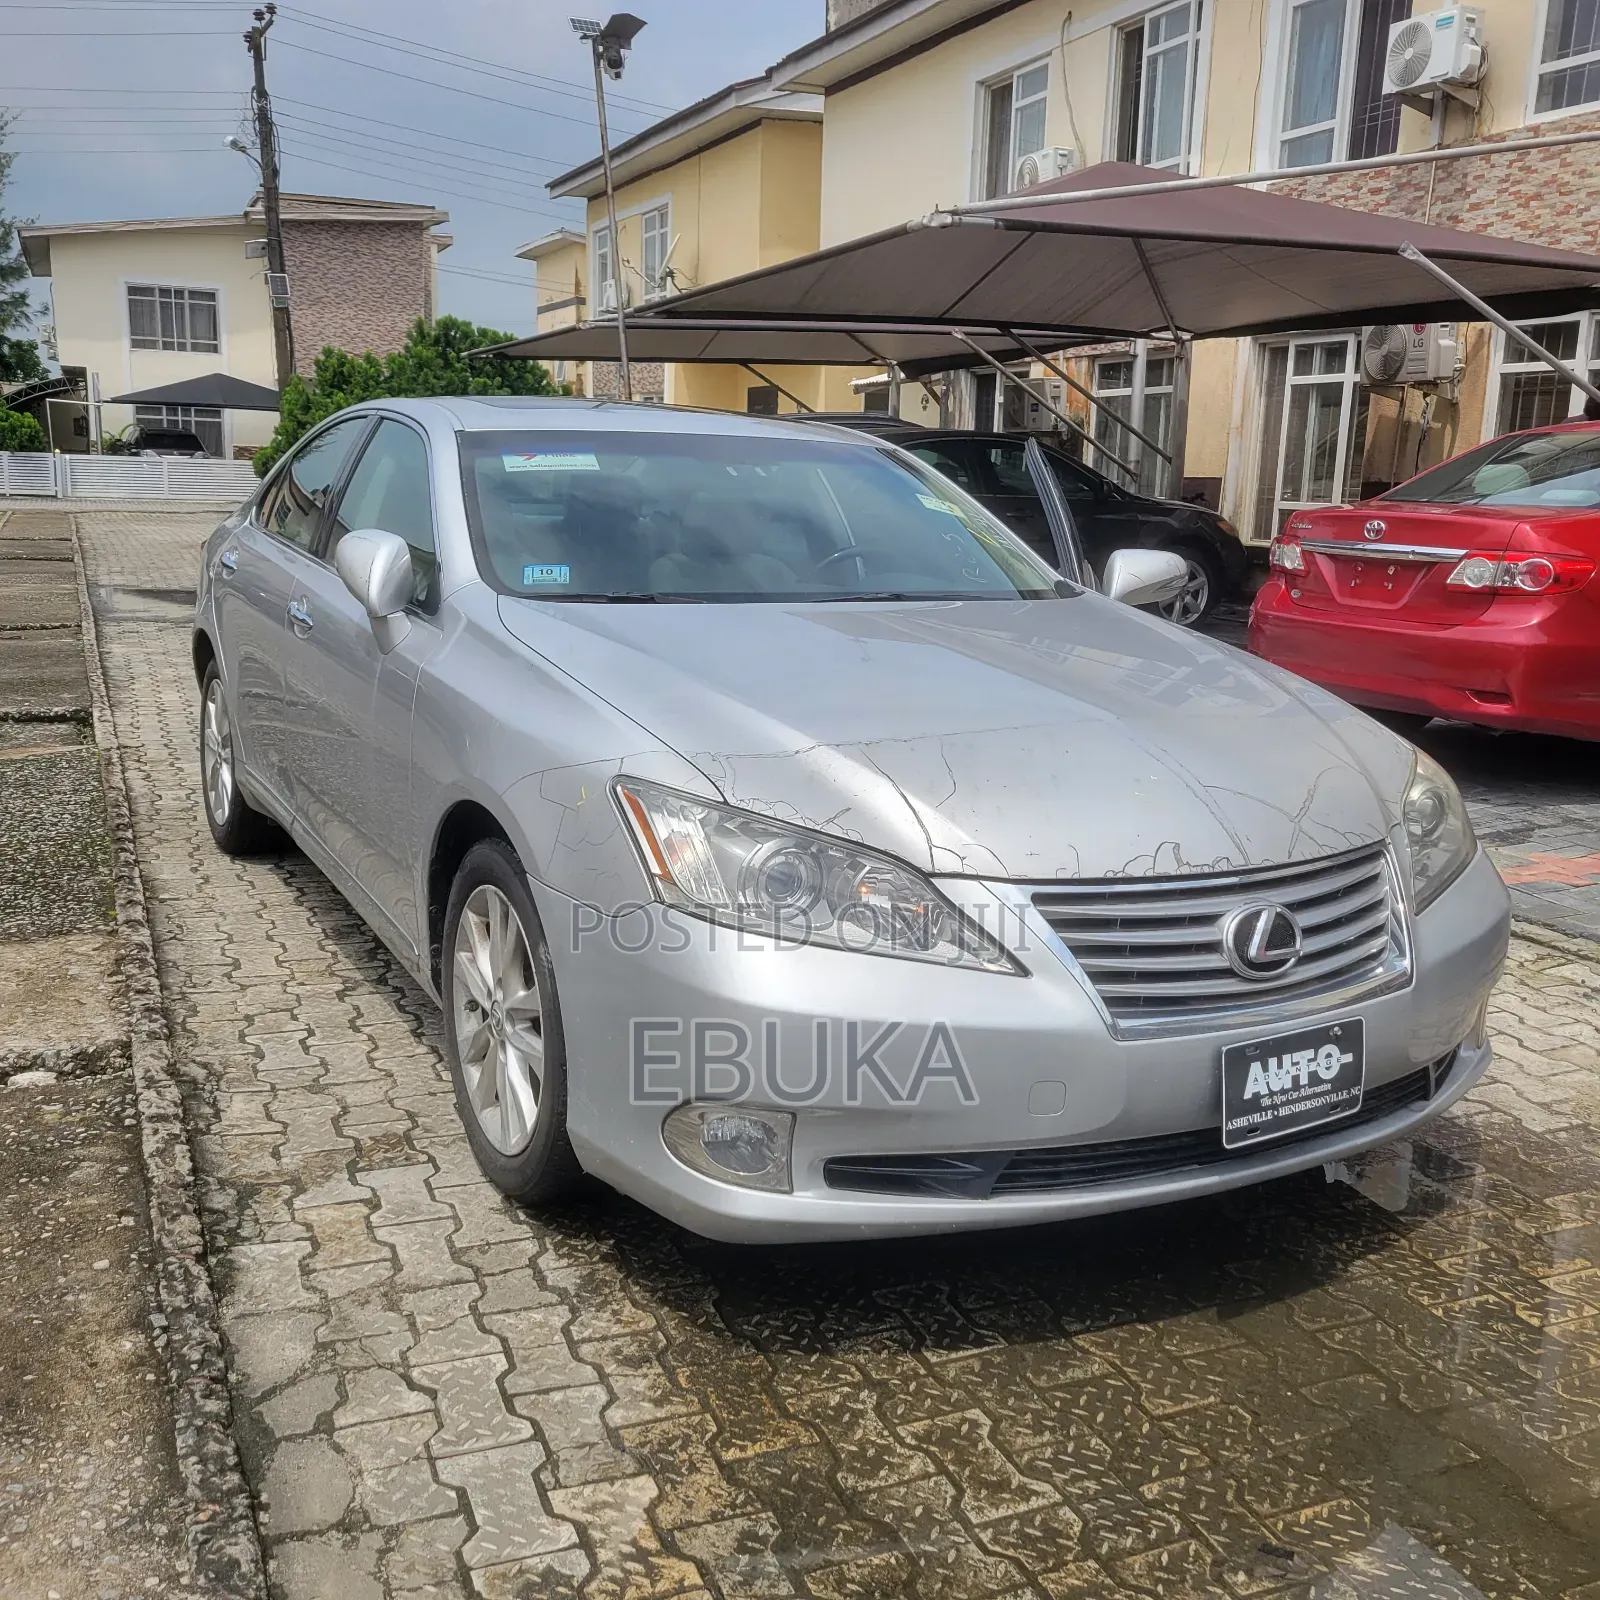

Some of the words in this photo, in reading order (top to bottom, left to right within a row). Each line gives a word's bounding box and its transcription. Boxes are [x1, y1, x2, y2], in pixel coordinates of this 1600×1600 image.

[1412, 338, 1424, 348] LG
[539, 568, 553, 576] 10
[1243, 1044, 1341, 1099] AUTO
[1252, 1056, 1342, 1083] ADVANTAGE
[1226, 1110, 1273, 1130] ASHEVILLE
[1350, 1085, 1361, 1097] NC
[1260, 1098, 1272, 1107] The
[1273, 1093, 1287, 1104] New
[1287, 1090, 1299, 1100] Car
[1299, 1083, 1332, 1097] Alternative
